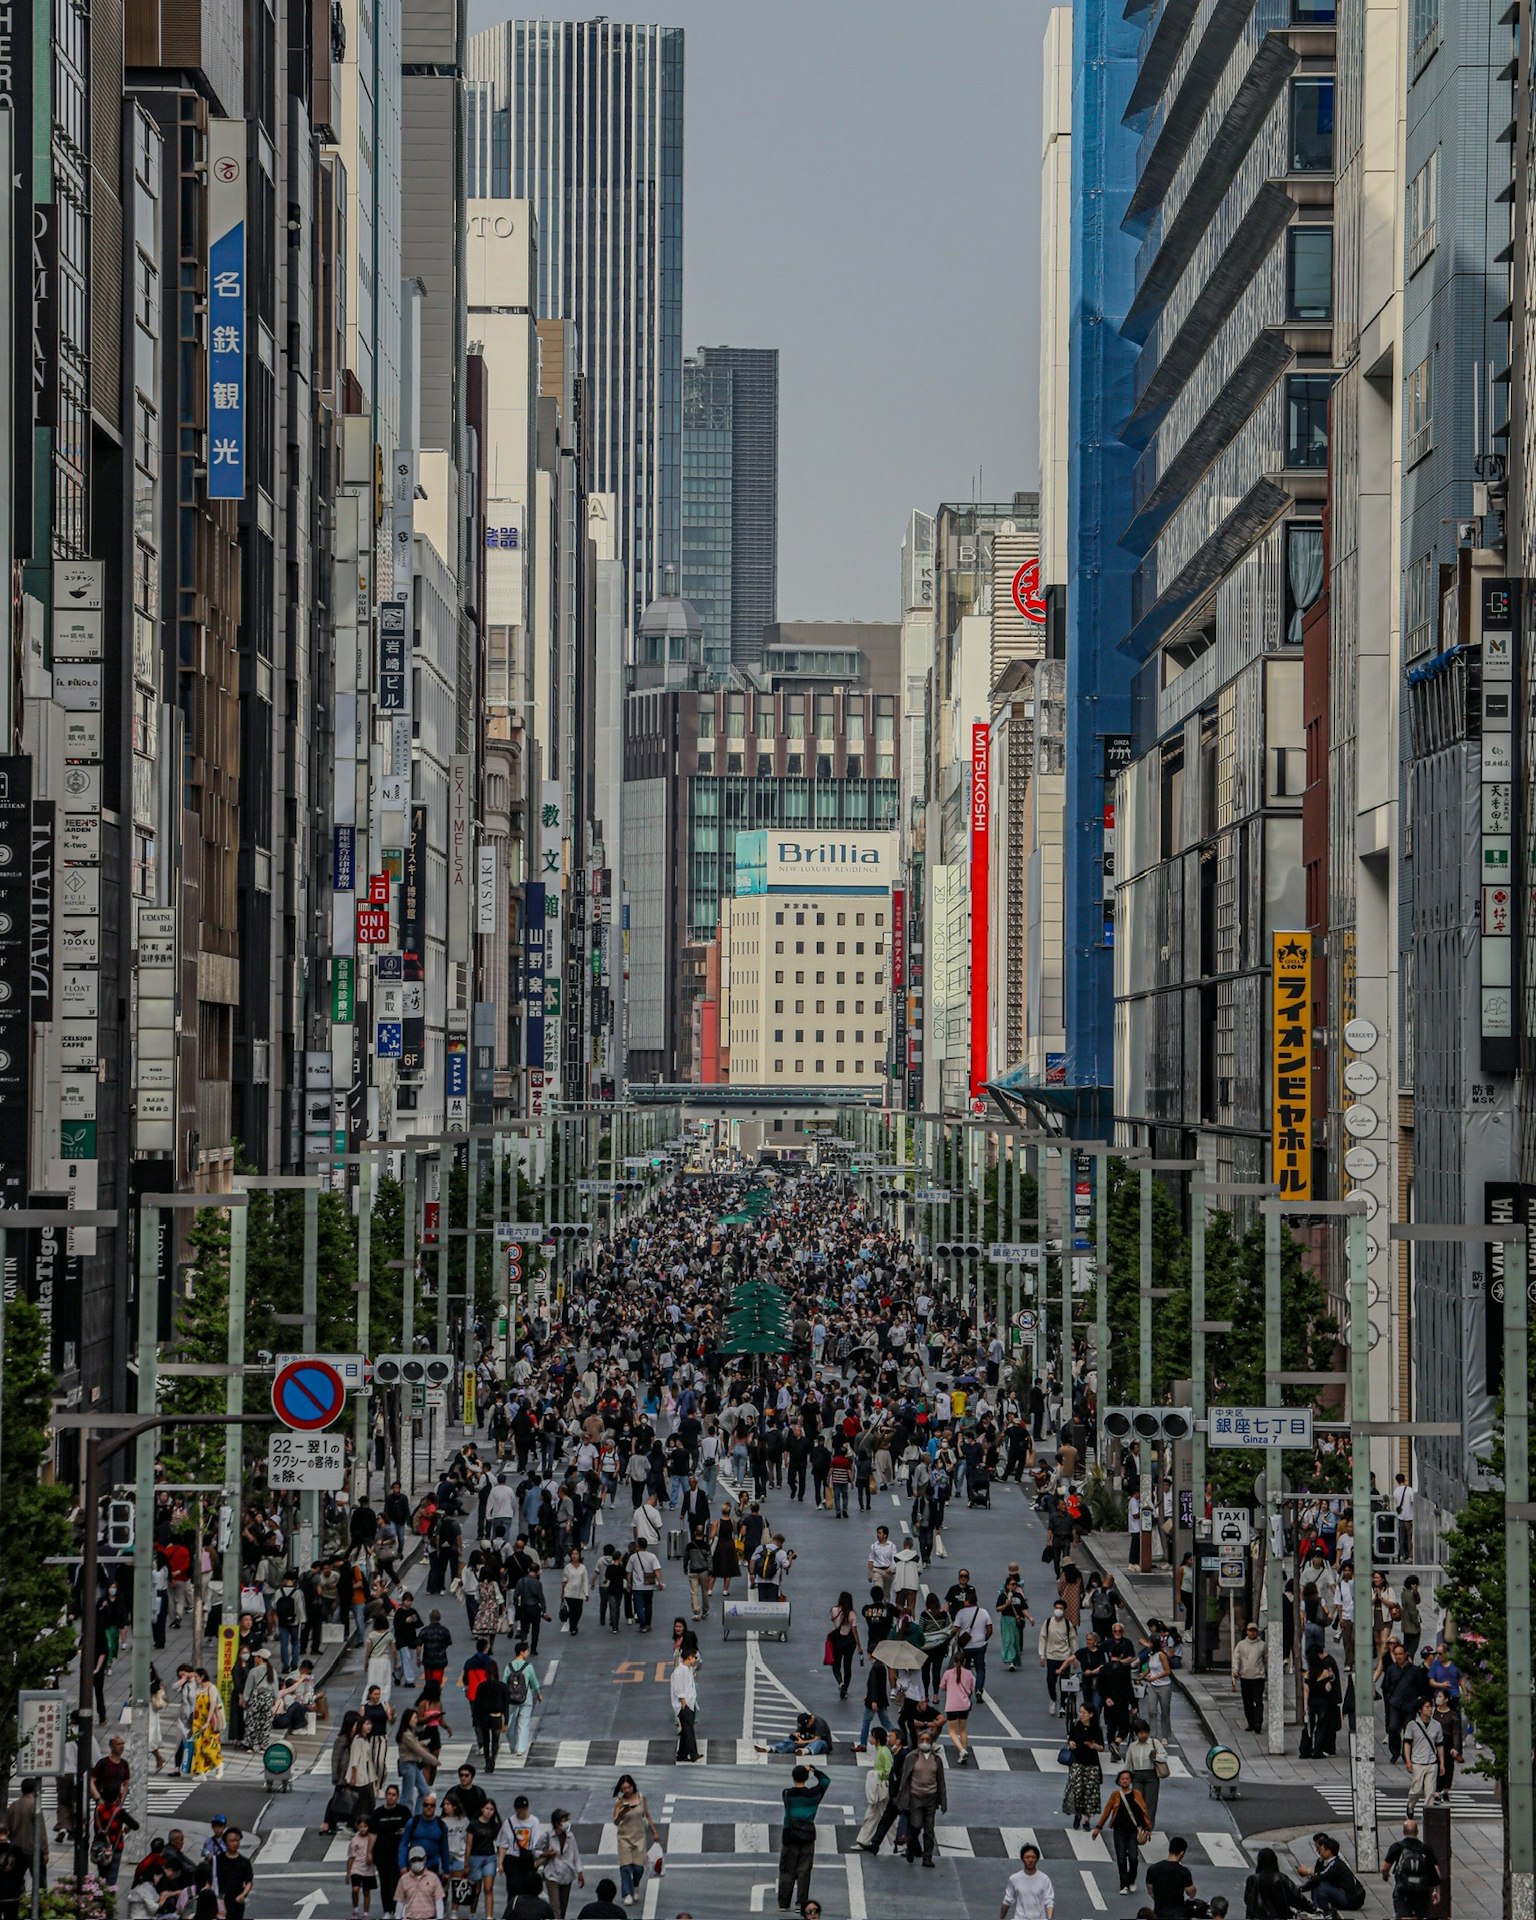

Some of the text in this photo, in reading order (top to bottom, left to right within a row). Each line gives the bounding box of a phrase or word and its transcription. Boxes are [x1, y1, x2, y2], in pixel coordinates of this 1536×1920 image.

[466, 215, 514, 239] TO
[213, 271, 241, 466] 名鉄観光
[385, 640, 400, 707] 岩崎ビル
[975, 731, 986, 832] MITSUKOSHI
[454, 766, 465, 886] EXITMELSA
[541, 803, 560, 919] 教文館
[778, 843, 881, 864] Brillia
[481, 857, 493, 925] TASAKI
[31, 821, 52, 1000] DAMIANI
[141, 914, 172, 922] UEMATSU
[159, 925, 173, 933] BLD
[360, 915, 384, 928] UNI
[360, 928, 386, 942] QLO
[529, 928, 544, 1017] 山野楽器
[337, 959, 349, 1021] 西銀座診療所
[385, 991, 395, 1012] 買取
[404, 1054, 418, 1066] 6F
[453, 1057, 462, 1092] PLAZA
[1277, 976, 1307, 1193] ライオンビヤホール
[1472, 1096, 1496, 1104] MSK
[1491, 1198, 1514, 1277] YAMHA
[36, 1226, 58, 1281] Tige
[992, 1248, 1039, 1258] 銀座六丁目
[1215, 1408, 1243, 1417] 中央区
[1215, 1418, 1305, 1434] 銀座七丁目
[1243, 1435, 1269, 1444] Ginza
[272, 1456, 340, 1469] タクシーの客待ち
[271, 1470, 304, 1484] を除く
[1217, 1512, 1246, 1521] TAXI
